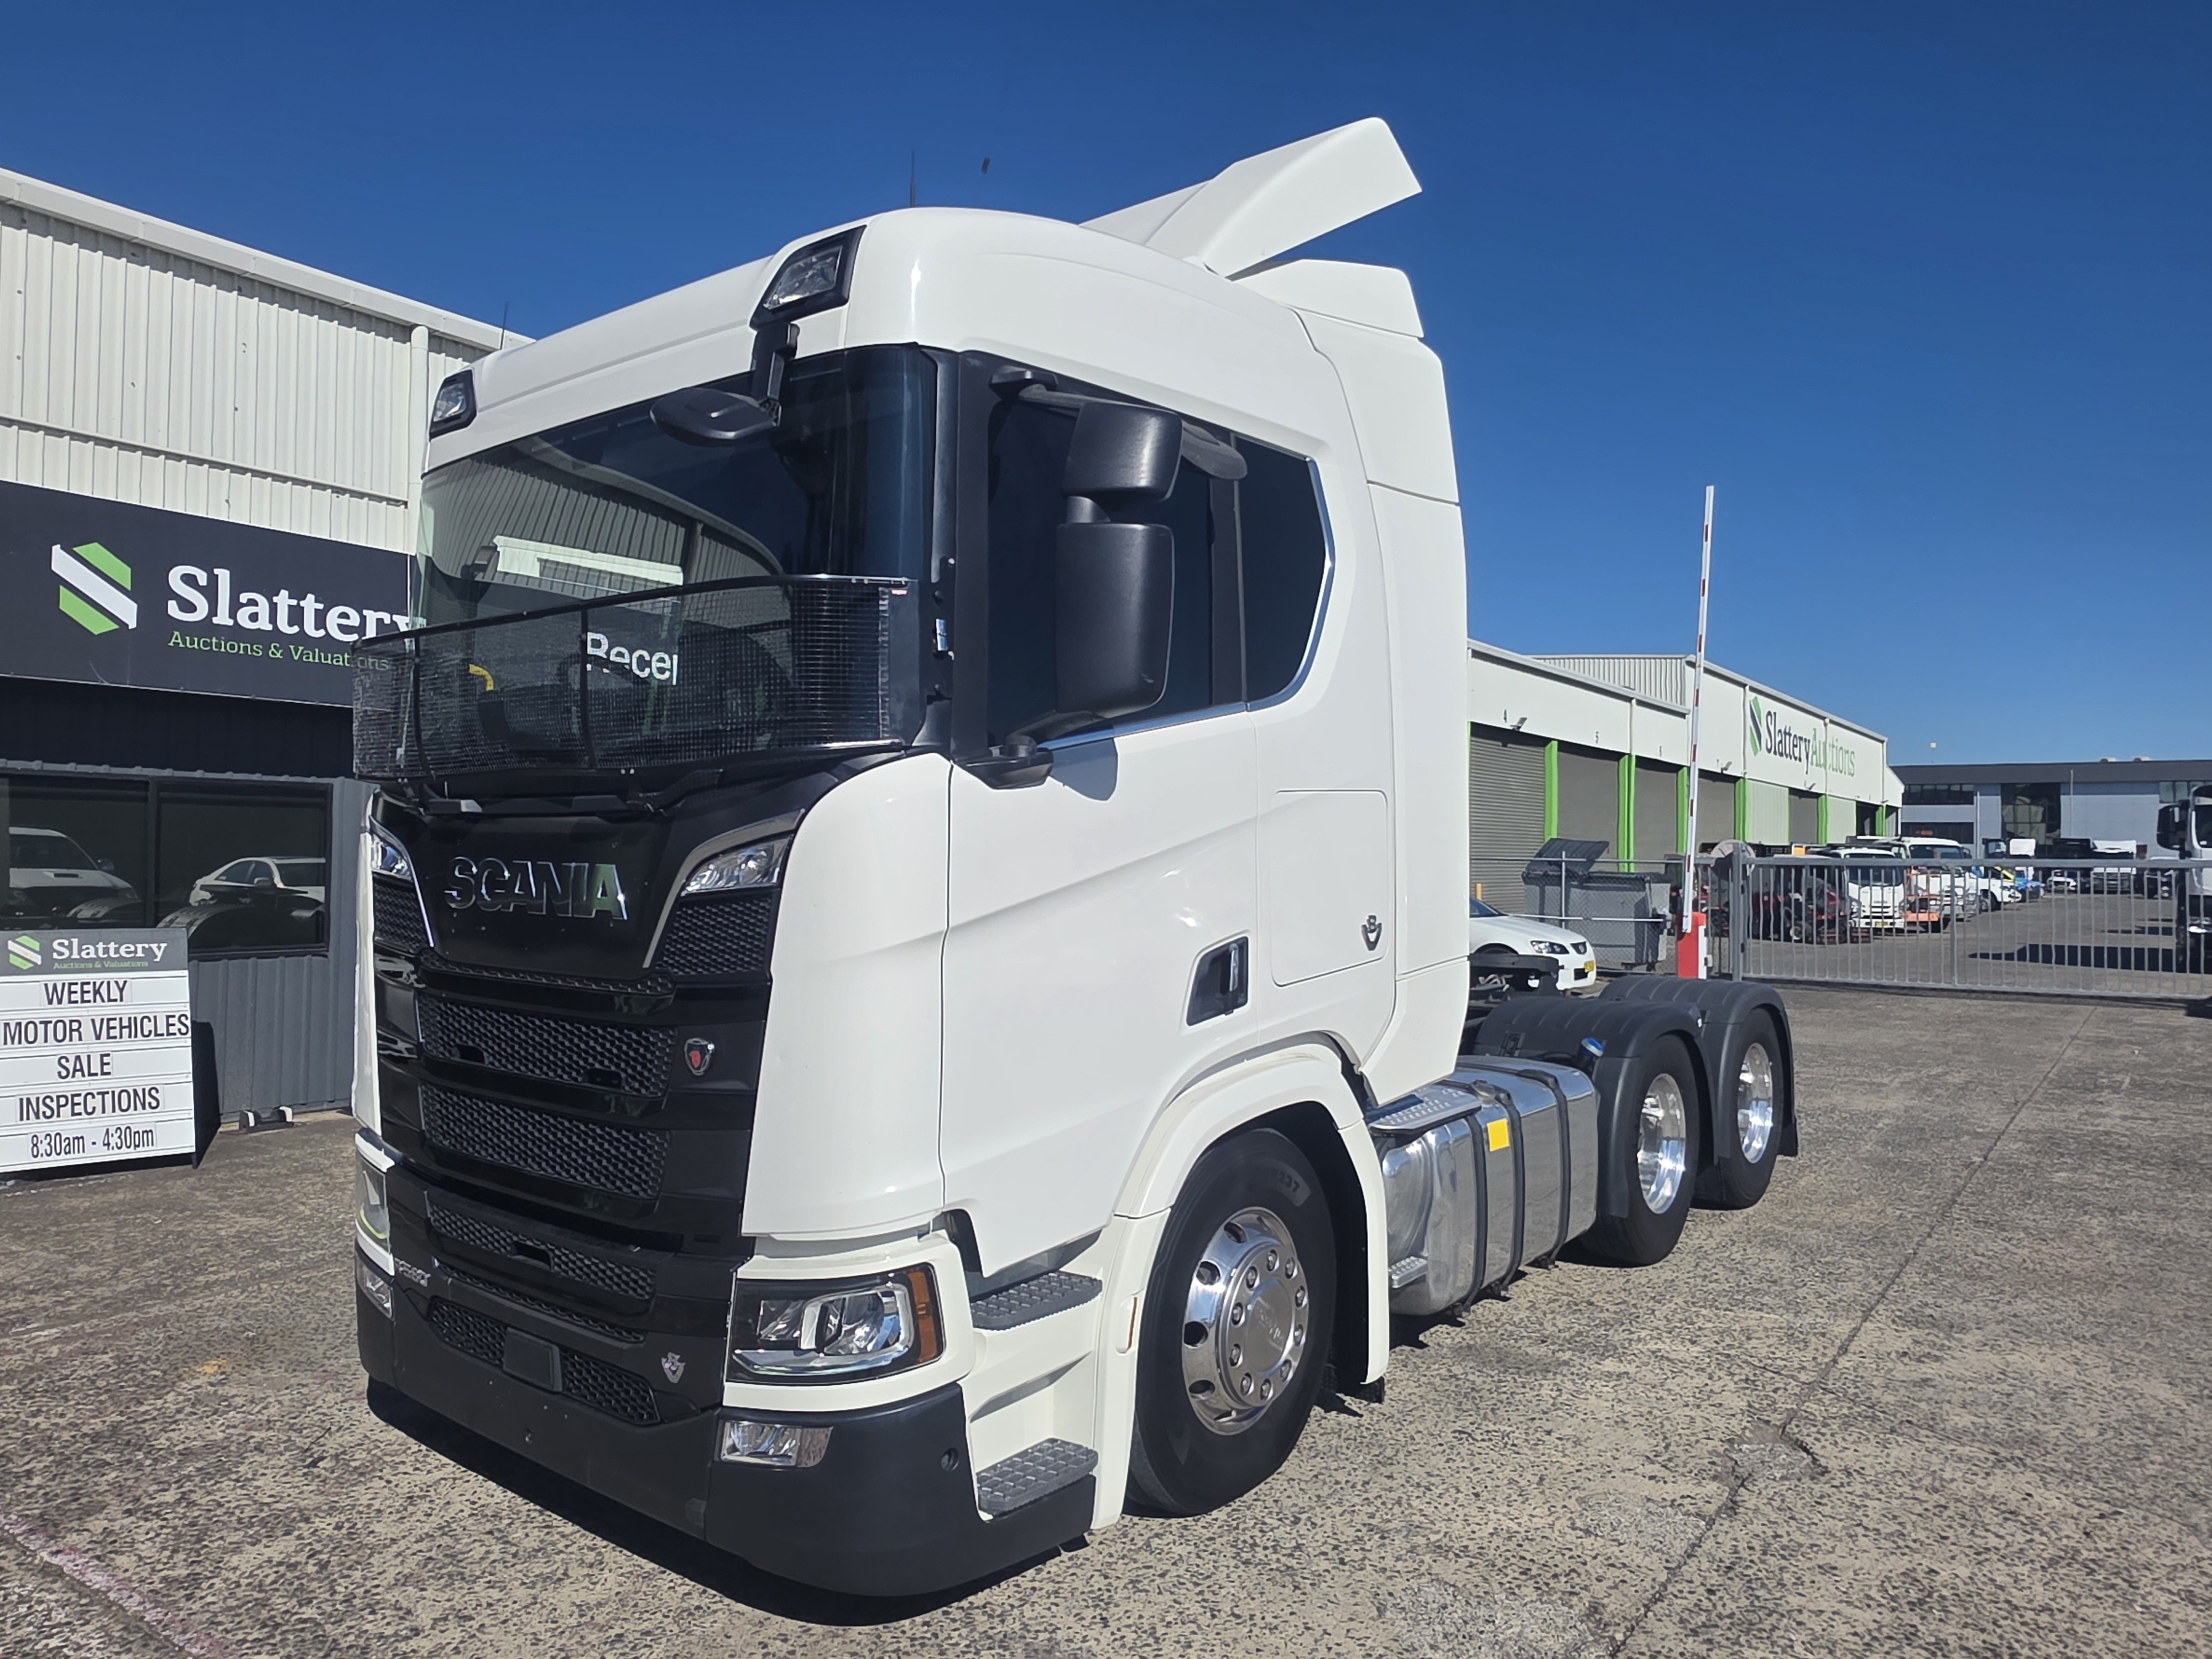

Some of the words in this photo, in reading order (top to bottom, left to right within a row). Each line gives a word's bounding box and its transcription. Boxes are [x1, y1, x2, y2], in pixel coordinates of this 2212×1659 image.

[168, 630, 263, 657] Auctions
[268, 643, 283, 659] &
[289, 645, 389, 670] Valuatons
[444, 856, 628, 920] SCANIA
[53, 939, 168, 961] Slattery
[53, 961, 94, 970] Auctions
[95, 961, 102, 969] &
[103, 959, 148, 968] Valuations
[44, 980, 128, 1005] WEEKLY
[3, 1019, 83, 1046] MOTOR
[91, 1014, 189, 1041] VEHICLES
[57, 1053, 111, 1079] SALE
[19, 1086, 160, 1121] INSPECTIONS
[102, 1126, 154, 1151] 4:30pm
